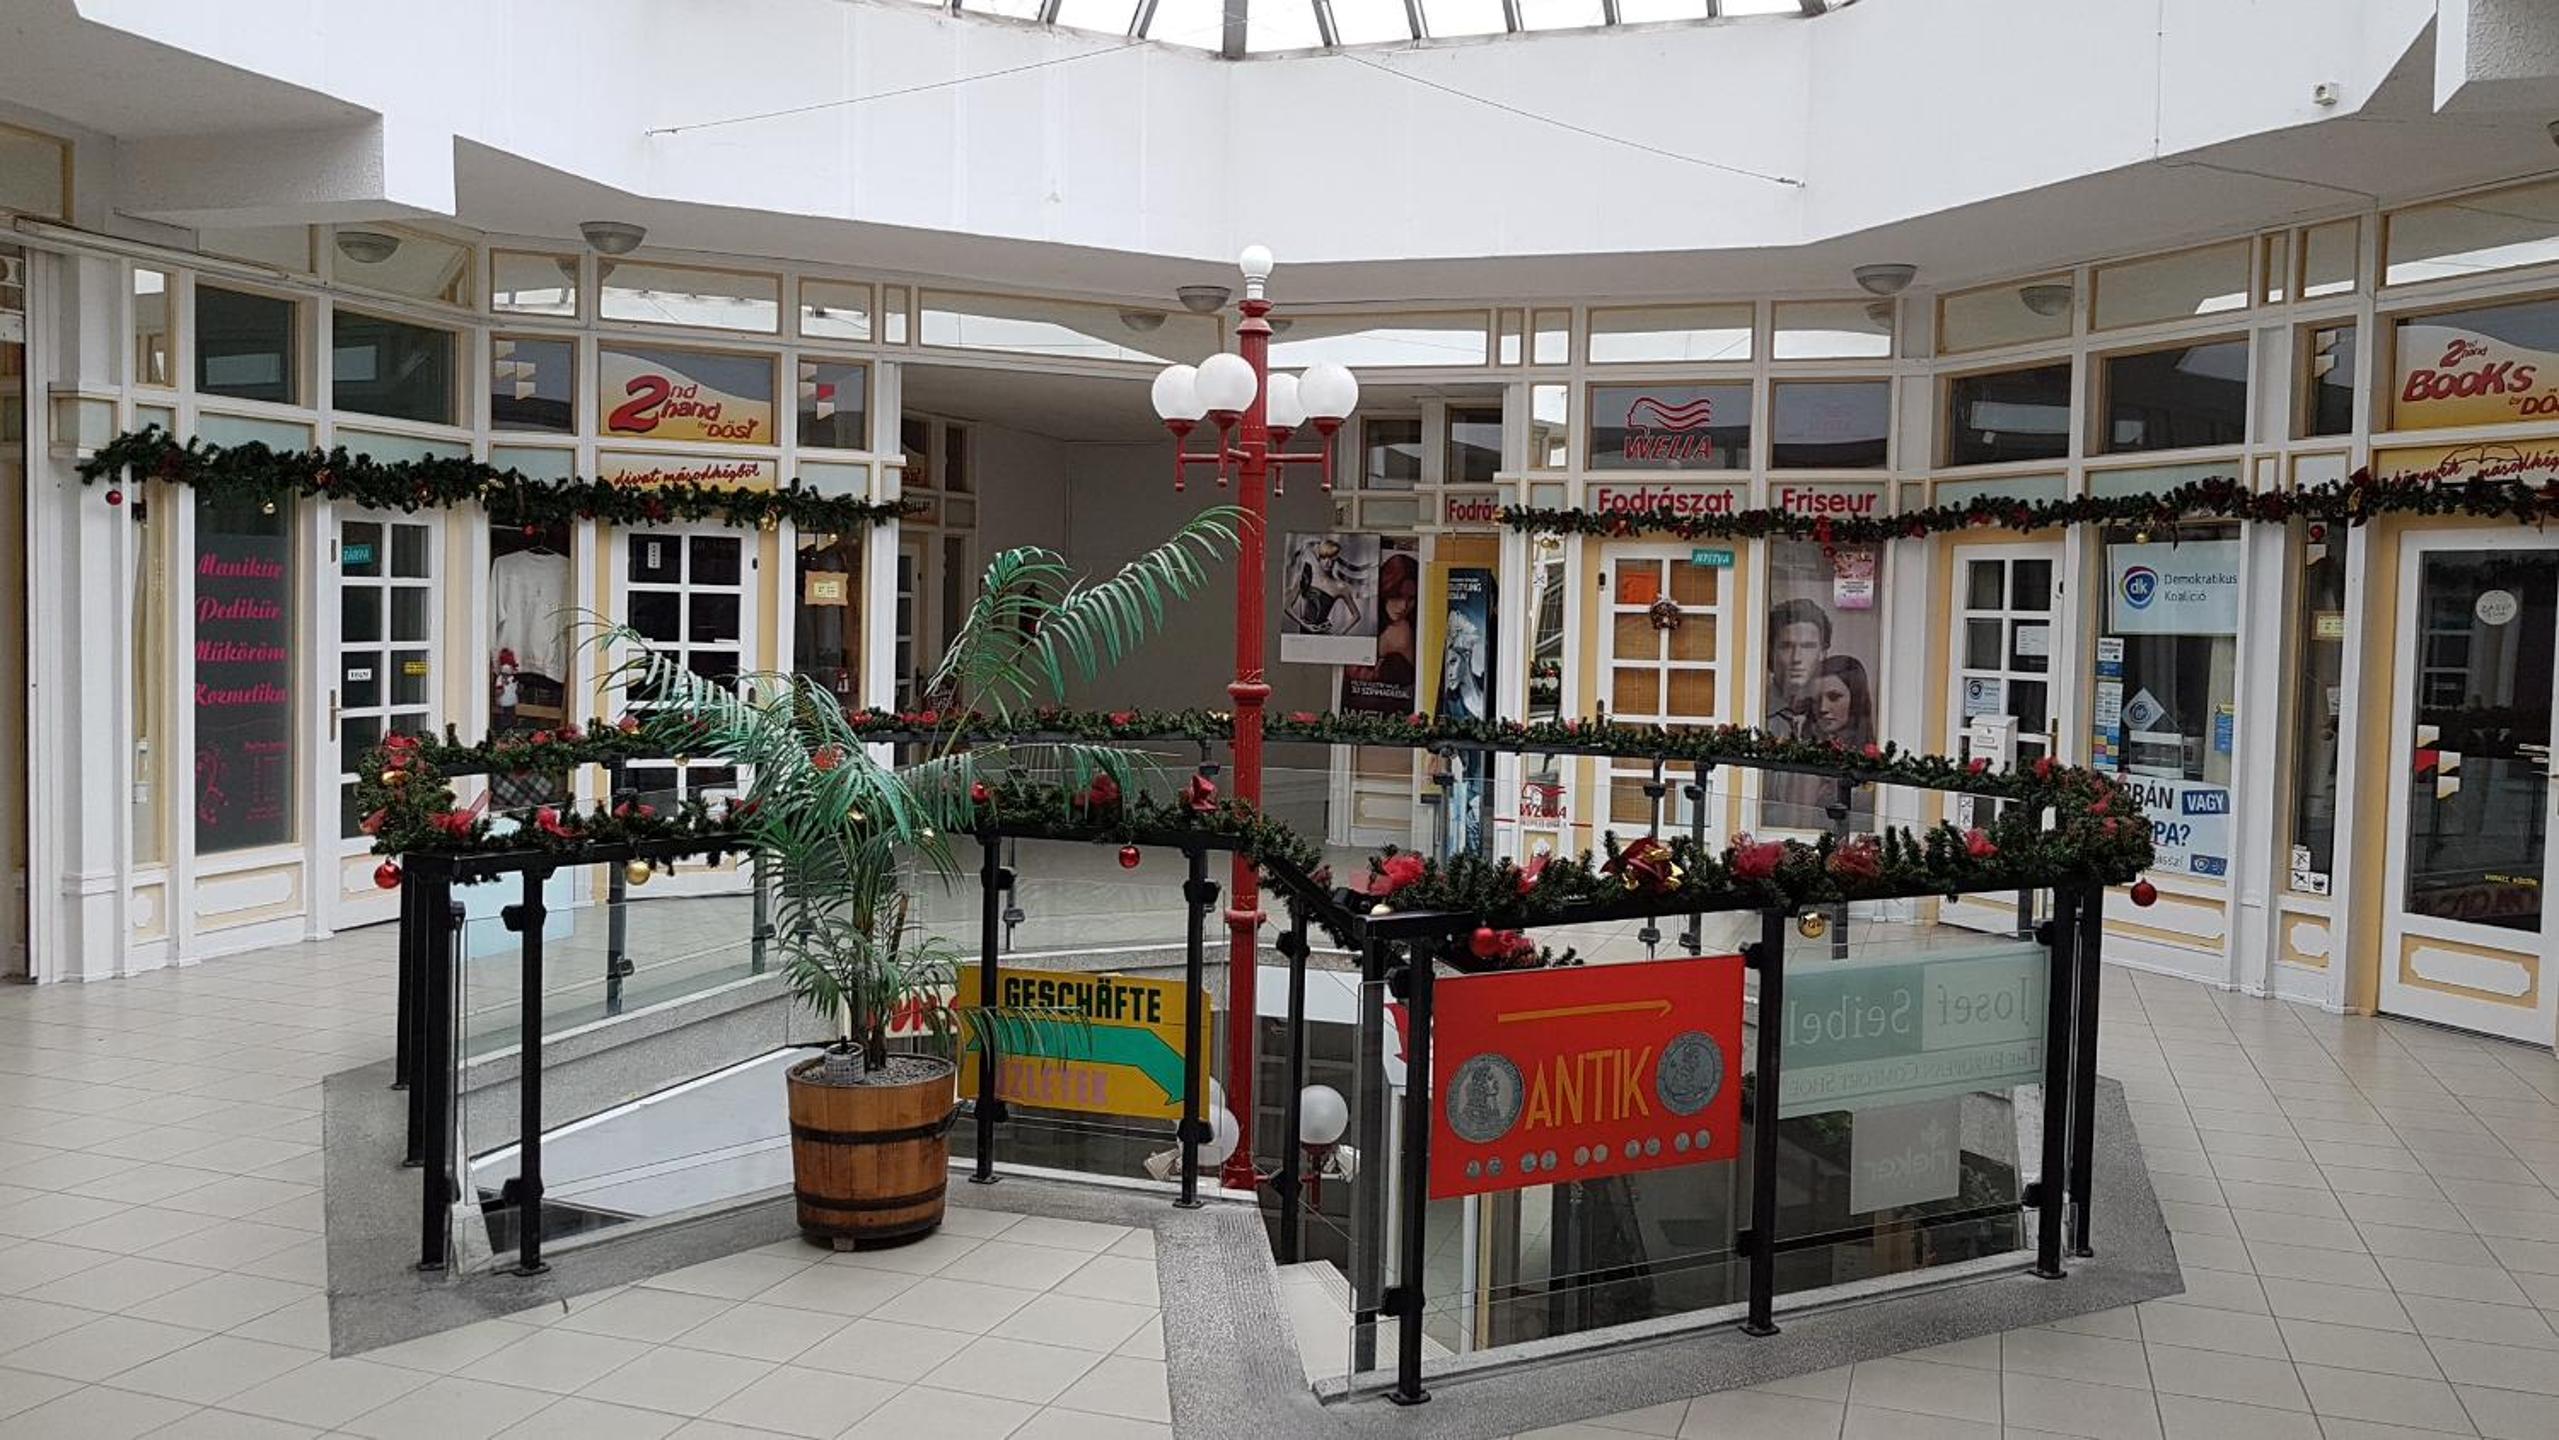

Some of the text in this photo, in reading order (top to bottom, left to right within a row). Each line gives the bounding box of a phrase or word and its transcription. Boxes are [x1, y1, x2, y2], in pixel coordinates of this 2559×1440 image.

[661, 399, 722, 421] hand
[2521, 388, 2559, 415] DÖ
[1624, 434, 1713, 461] WELLA
[614, 467, 662, 486] divat
[1598, 485, 1734, 513] Fodrászat
[1782, 487, 1877, 513] Friseur
[197, 552, 283, 580] Manikür
[2130, 573, 2238, 595] dk Demokratikus
[196, 595, 281, 624] Pedikür
[195, 682, 288, 707] Kozmetika
[2124, 780, 2224, 811] BÁN VAGY
[1004, 977, 1161, 1024] GESCHÄFTE
[1524, 1046, 1652, 1131] ANTIK
